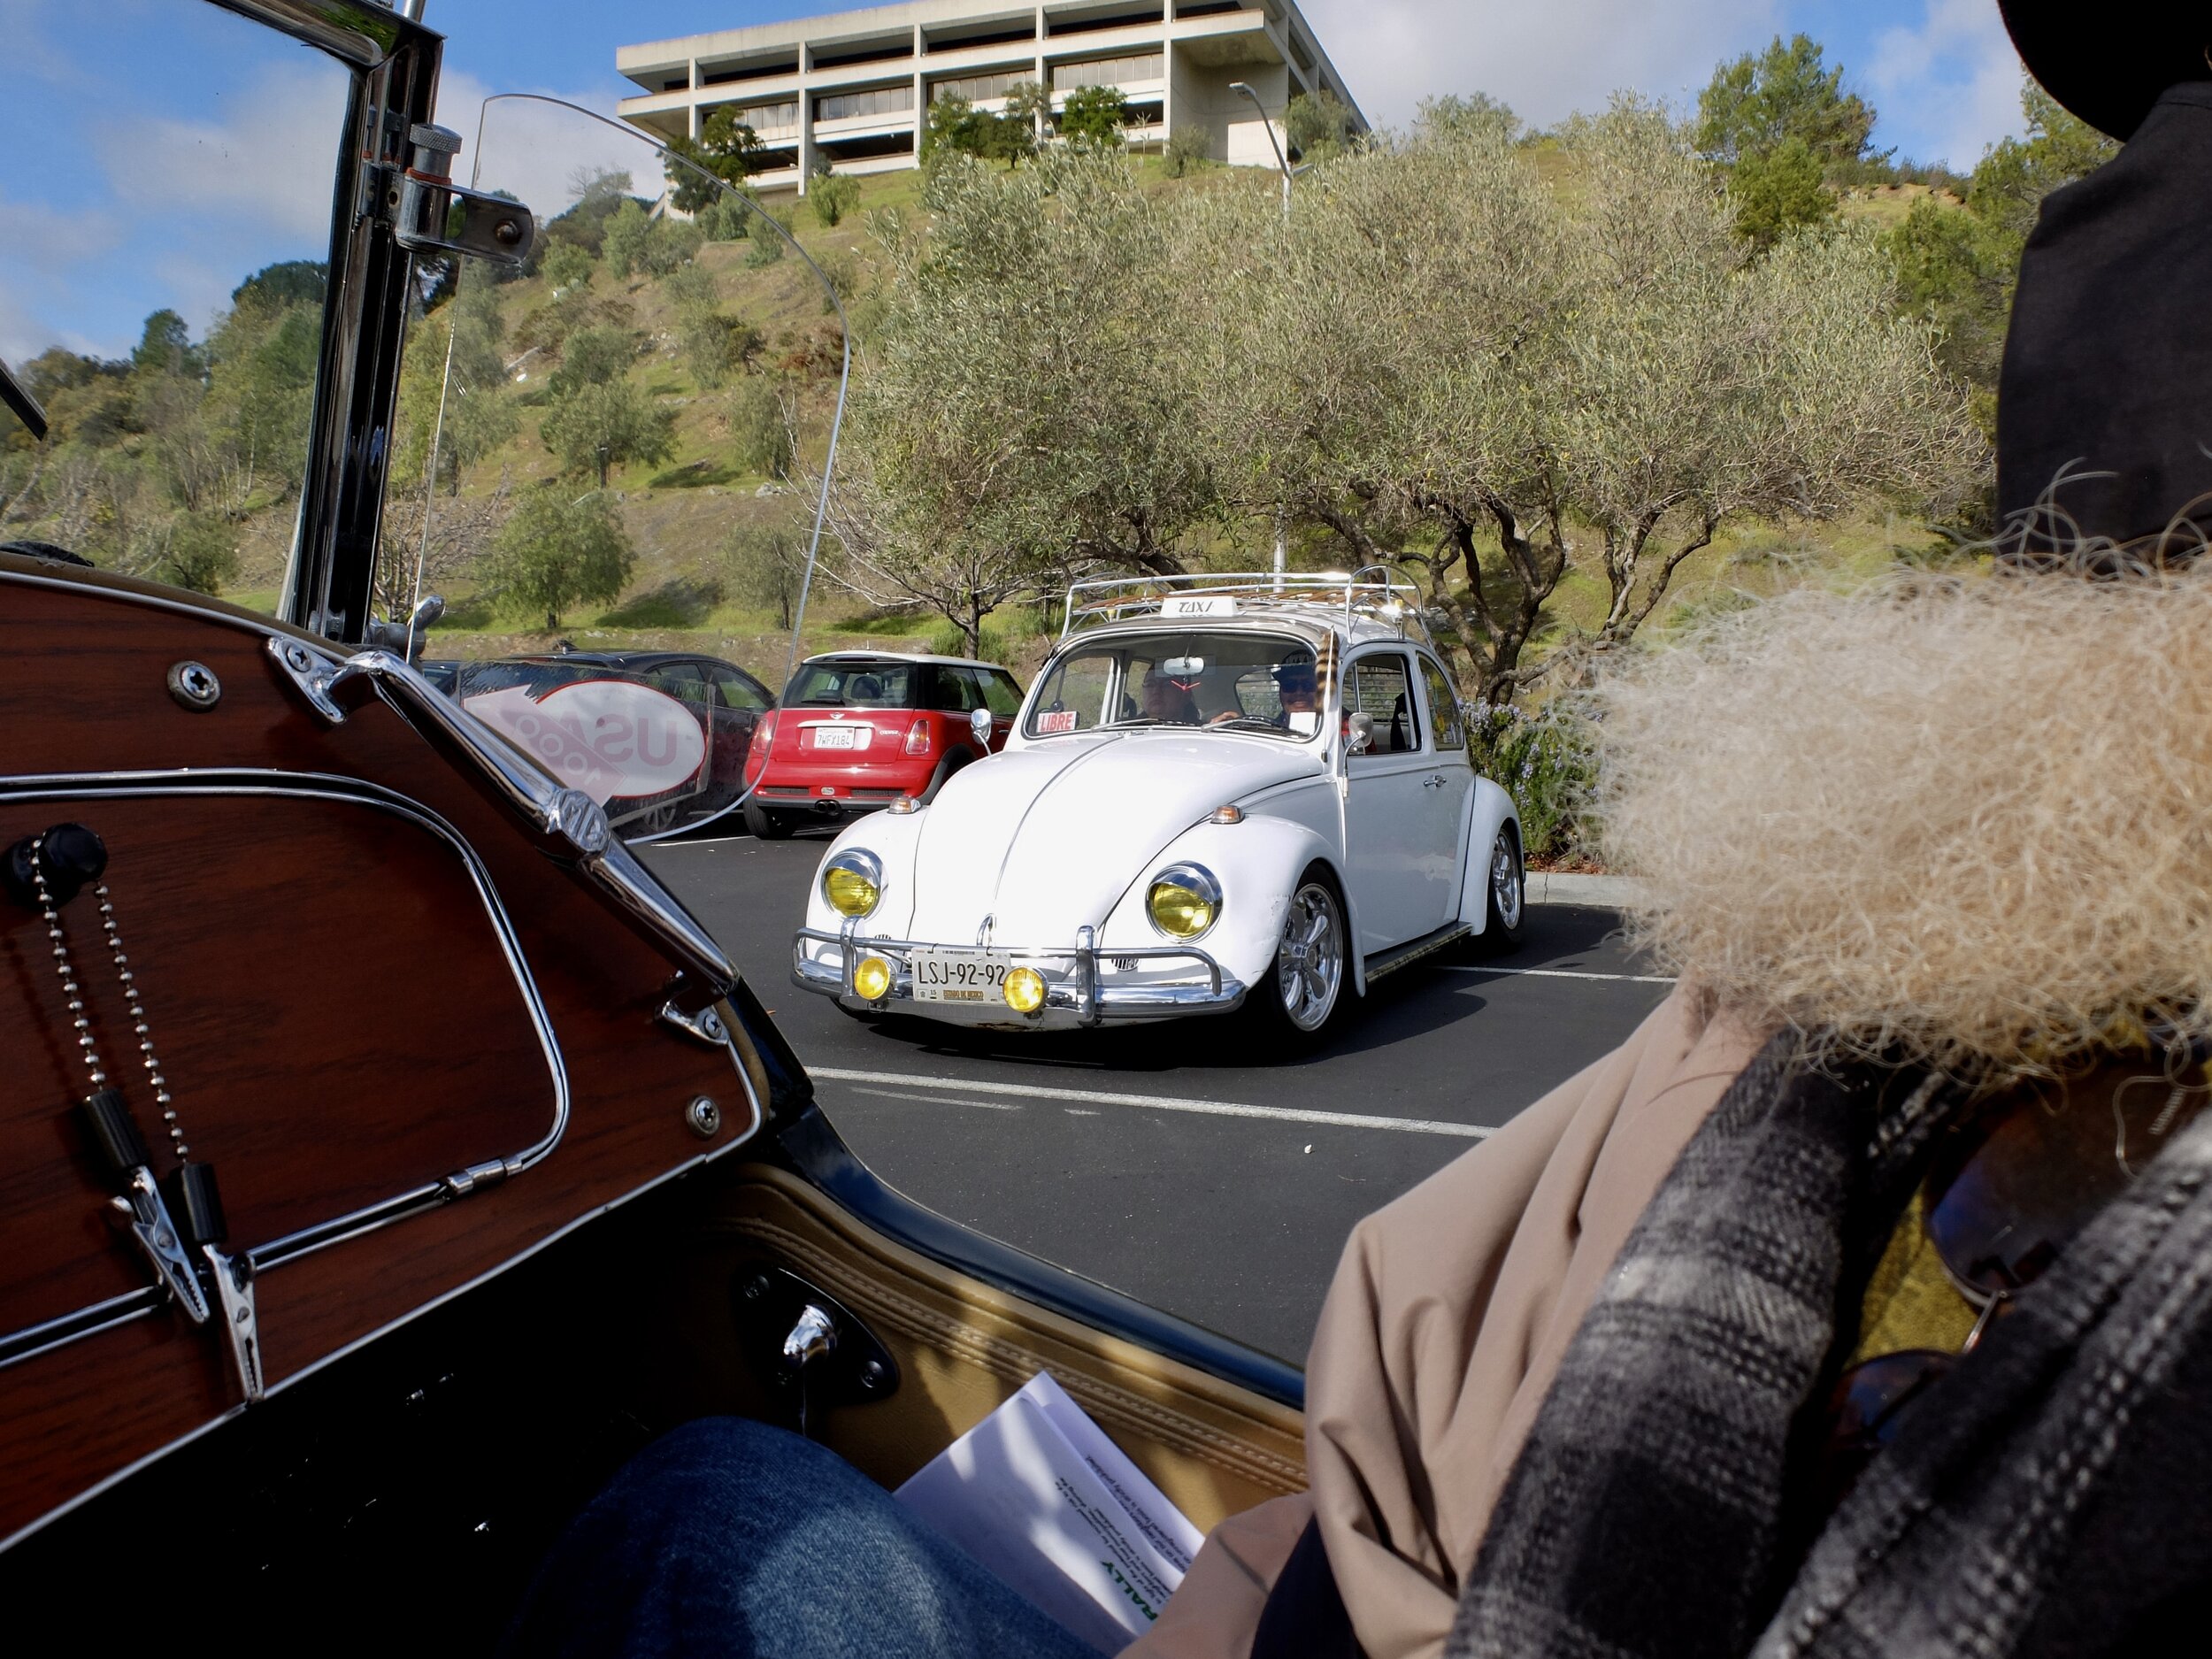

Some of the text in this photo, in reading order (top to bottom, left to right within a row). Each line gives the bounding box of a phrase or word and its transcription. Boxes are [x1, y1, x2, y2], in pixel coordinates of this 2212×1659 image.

[1179, 601, 1213, 612] TAXI
[1041, 713, 1072, 731] LIBRE
[918, 961, 1005, 986] LSJ-92-92
[1102, 1561, 1158, 1621] RALLY
